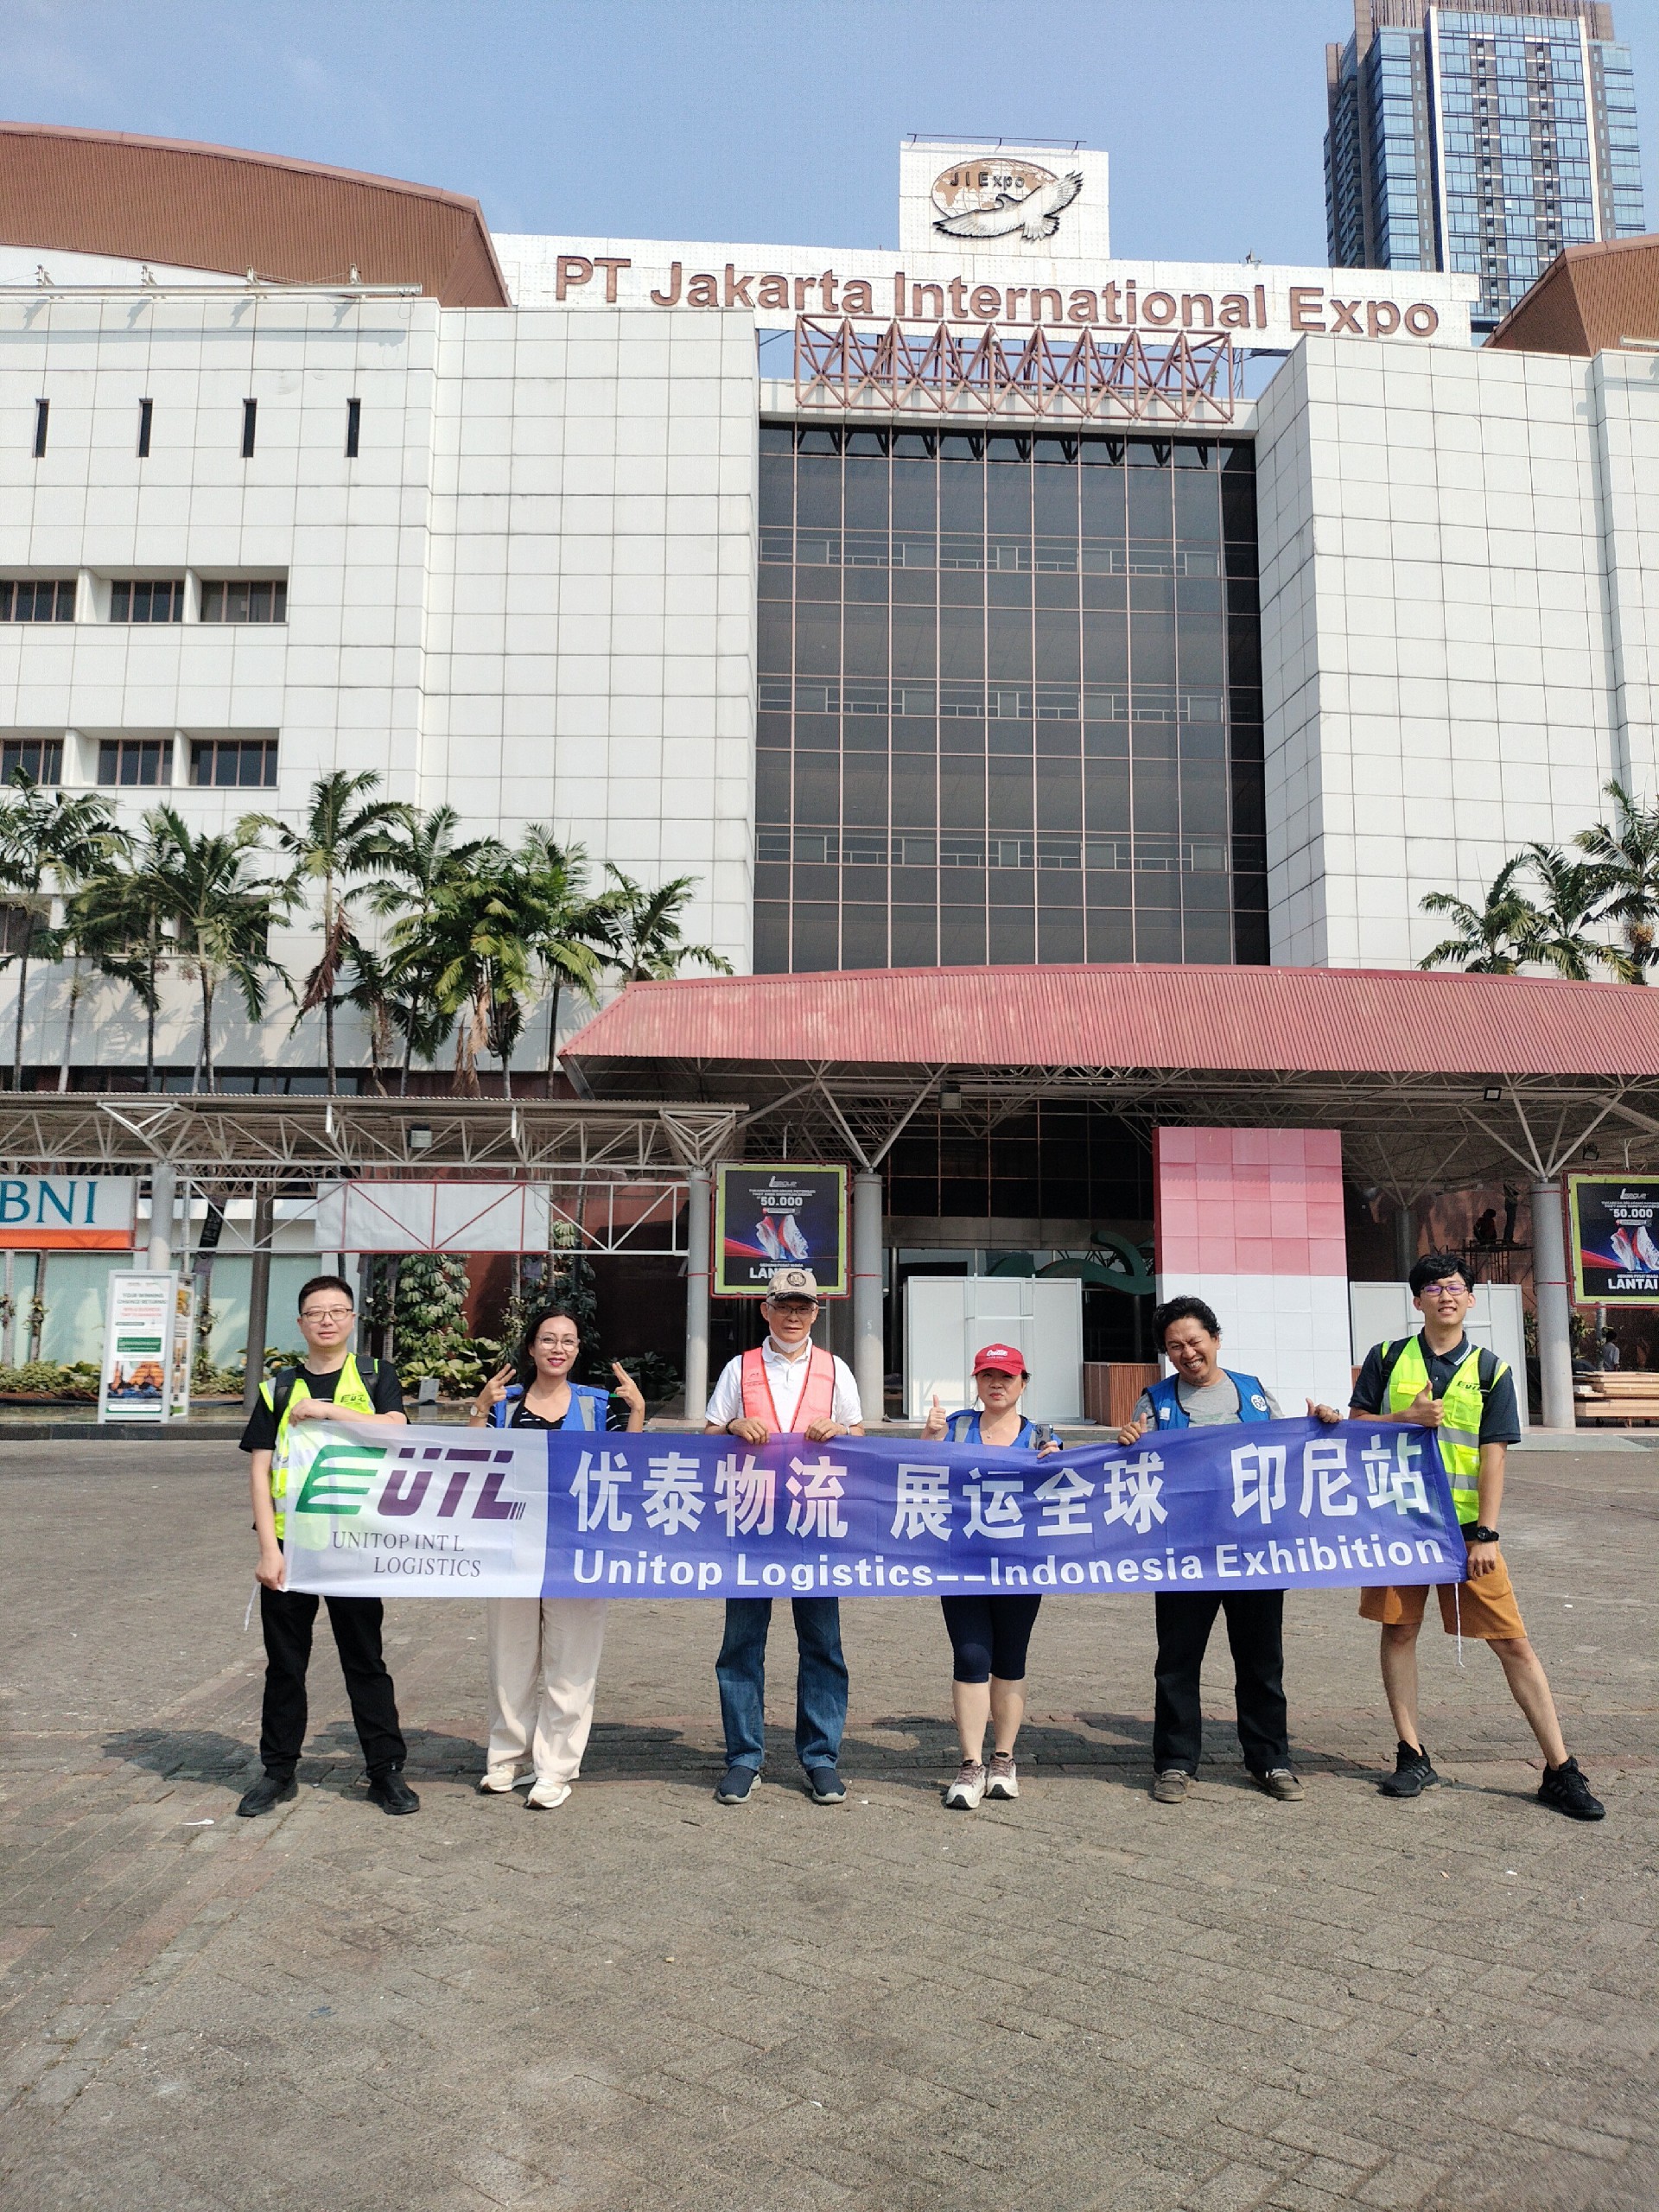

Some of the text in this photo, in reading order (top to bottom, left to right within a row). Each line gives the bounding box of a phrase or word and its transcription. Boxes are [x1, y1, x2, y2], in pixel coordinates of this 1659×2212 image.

[556, 255, 1440, 337] PT Jakarta International Expo
[0, 1180, 98, 1224] BNI
[760, 1196, 803, 1206] 50.000
[1613, 1208, 1654, 1218] 50.000
[1607, 1278, 1658, 1290] LANTAI
[569, 1432, 1430, 1542] 优泰物流 展运全球 印尼站
[332, 1531, 410, 1550] UNITOP
[373, 1556, 481, 1578] LOGISTICS
[573, 1549, 722, 1591] Unitop
[1216, 1534, 1445, 1579] Exhibition
